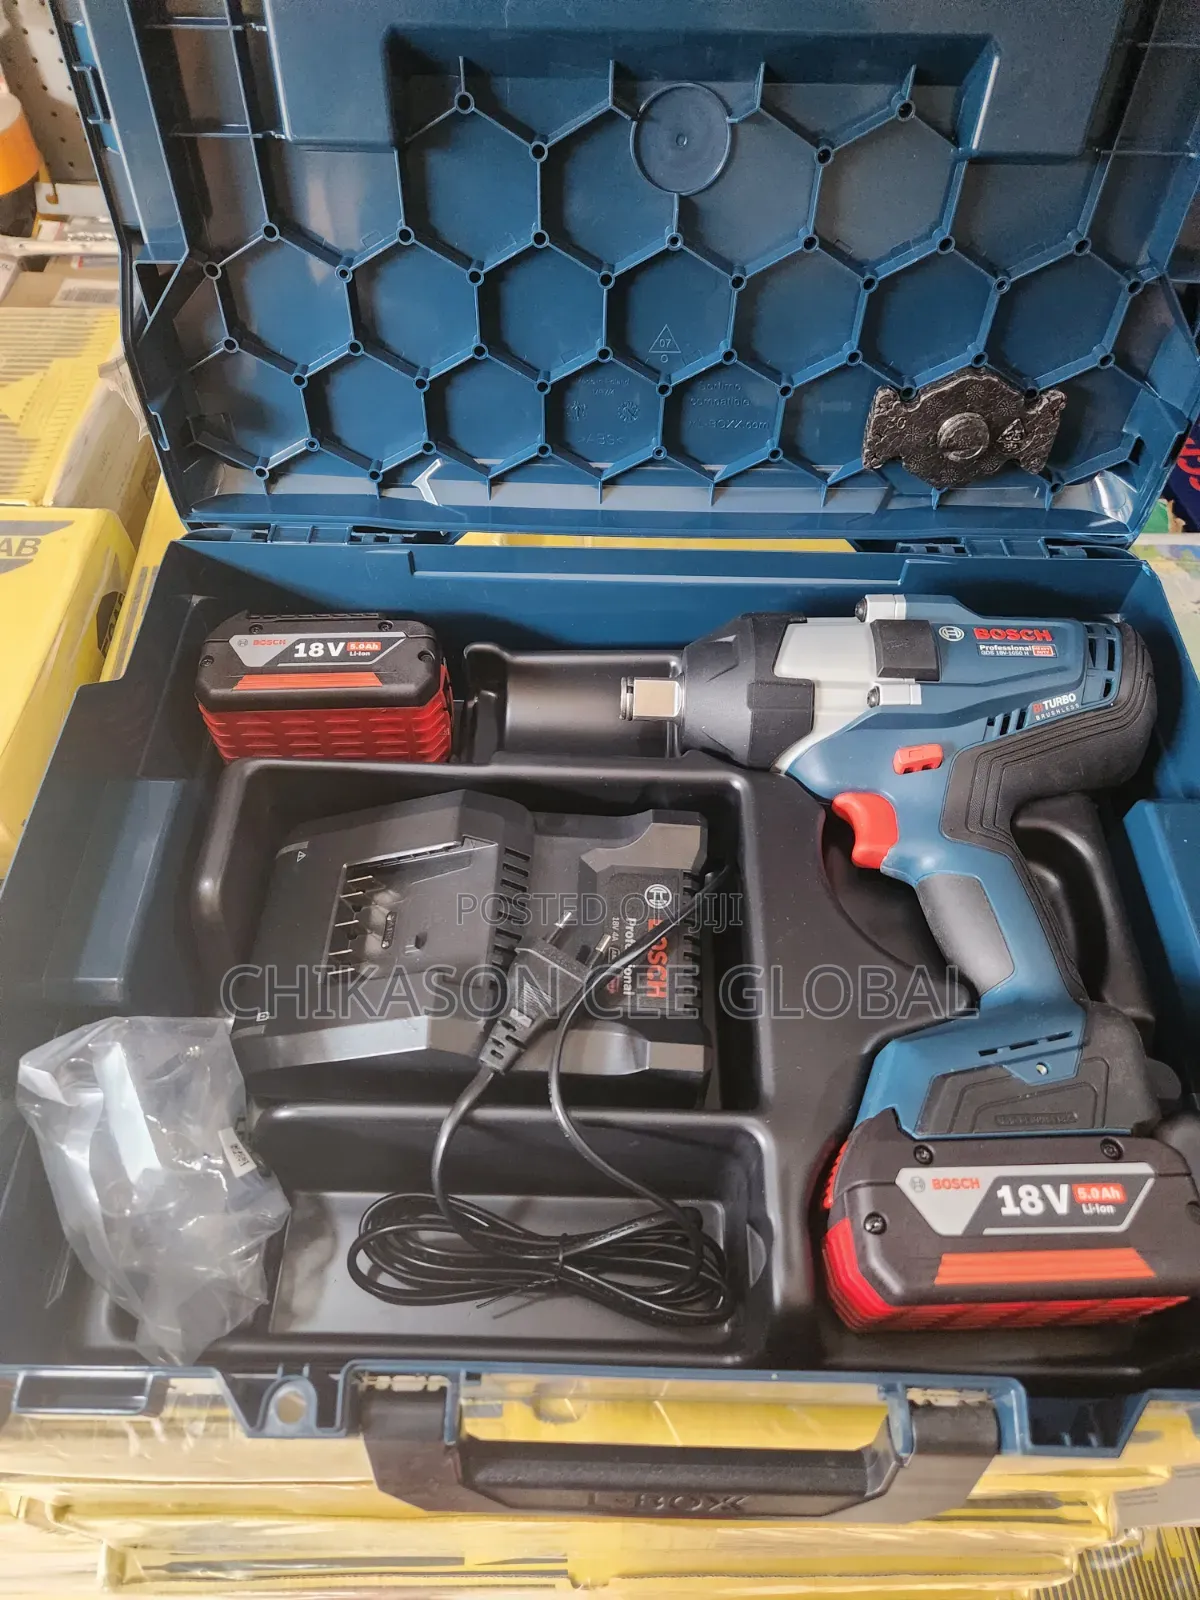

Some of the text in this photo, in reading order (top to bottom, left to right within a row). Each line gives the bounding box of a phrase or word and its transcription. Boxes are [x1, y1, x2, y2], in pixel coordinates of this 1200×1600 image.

[658, 337, 673, 349] 07
[973, 627, 1054, 642] BOSCH
[252, 638, 287, 646] BOSCH
[979, 644, 1033, 652] Professional
[1035, 703, 1080, 721] BRUSHLESS
[611, 917, 620, 930] 18V
[611, 931, 620, 942] 4A
[623, 917, 637, 996] Profional
[931, 1177, 980, 1190] BOSCH
[996, 1183, 1071, 1217] 18V
